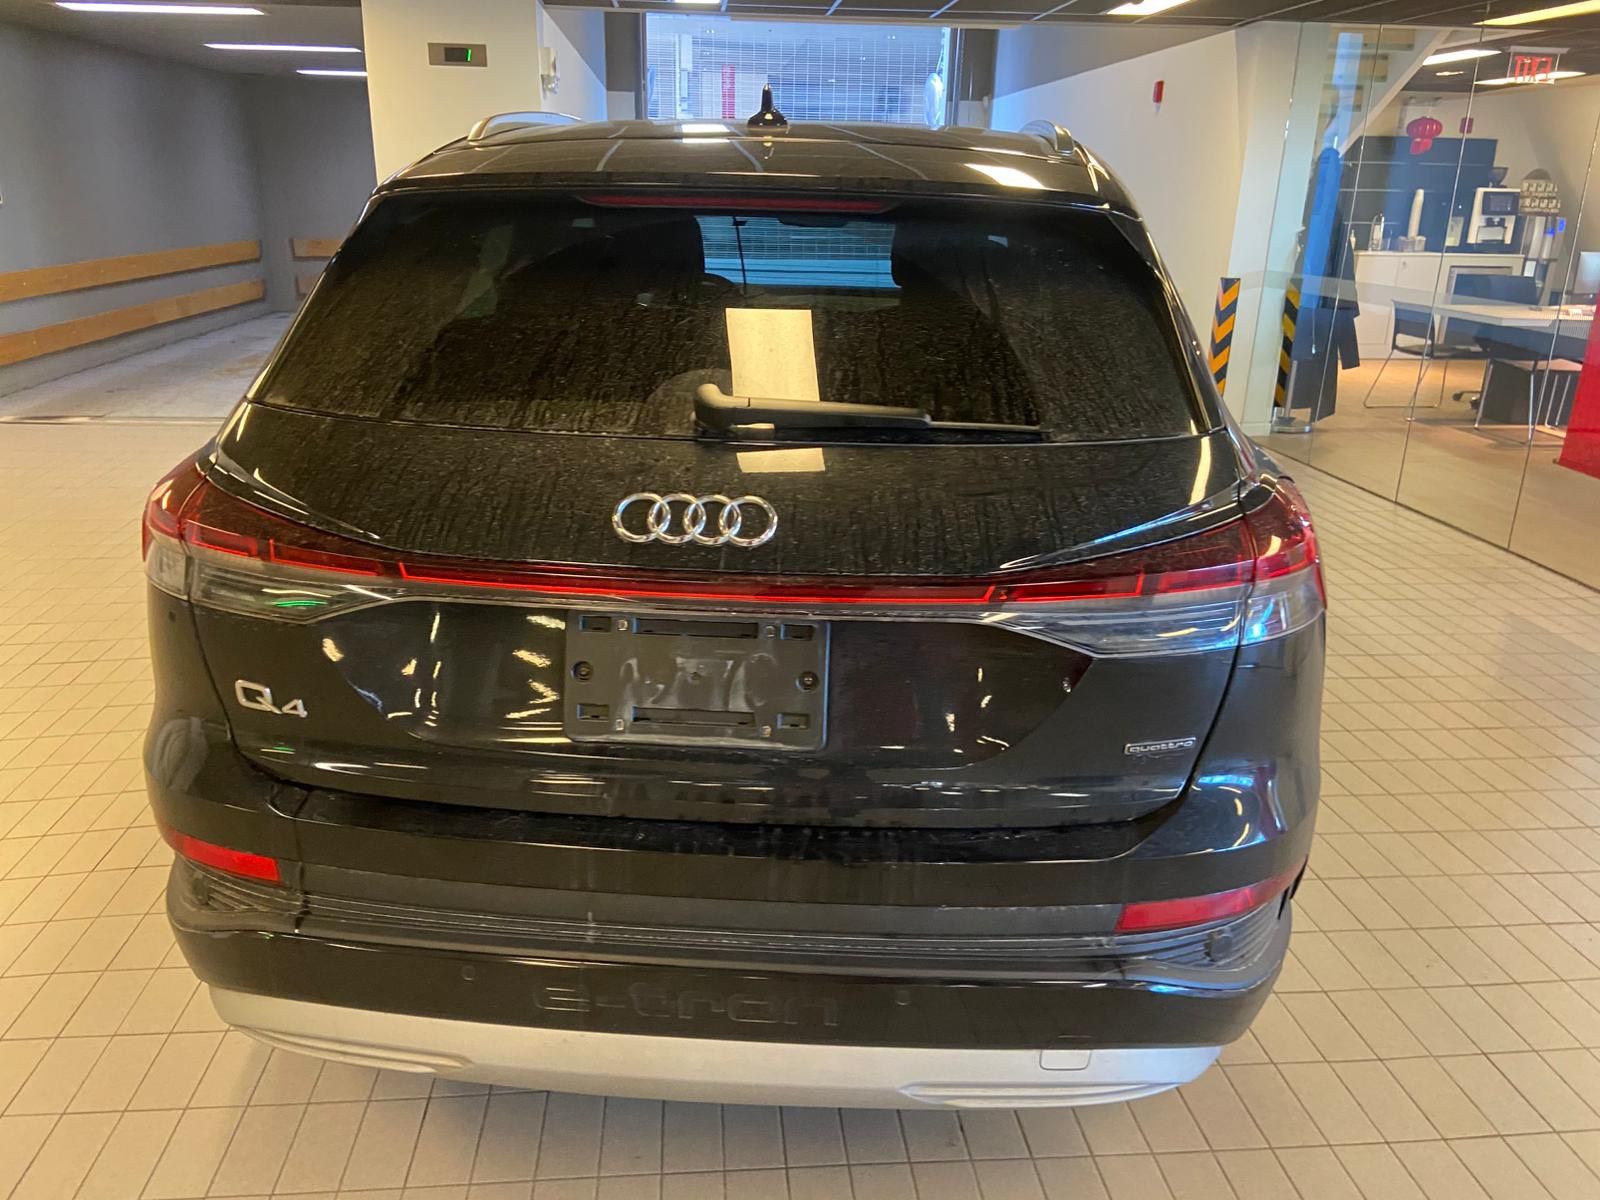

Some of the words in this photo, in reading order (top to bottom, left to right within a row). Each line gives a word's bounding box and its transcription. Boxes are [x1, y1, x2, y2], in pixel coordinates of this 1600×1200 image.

[234, 679, 308, 718] Q4
[1128, 740, 1194, 754] quattro
[531, 981, 839, 1027] e-tron
